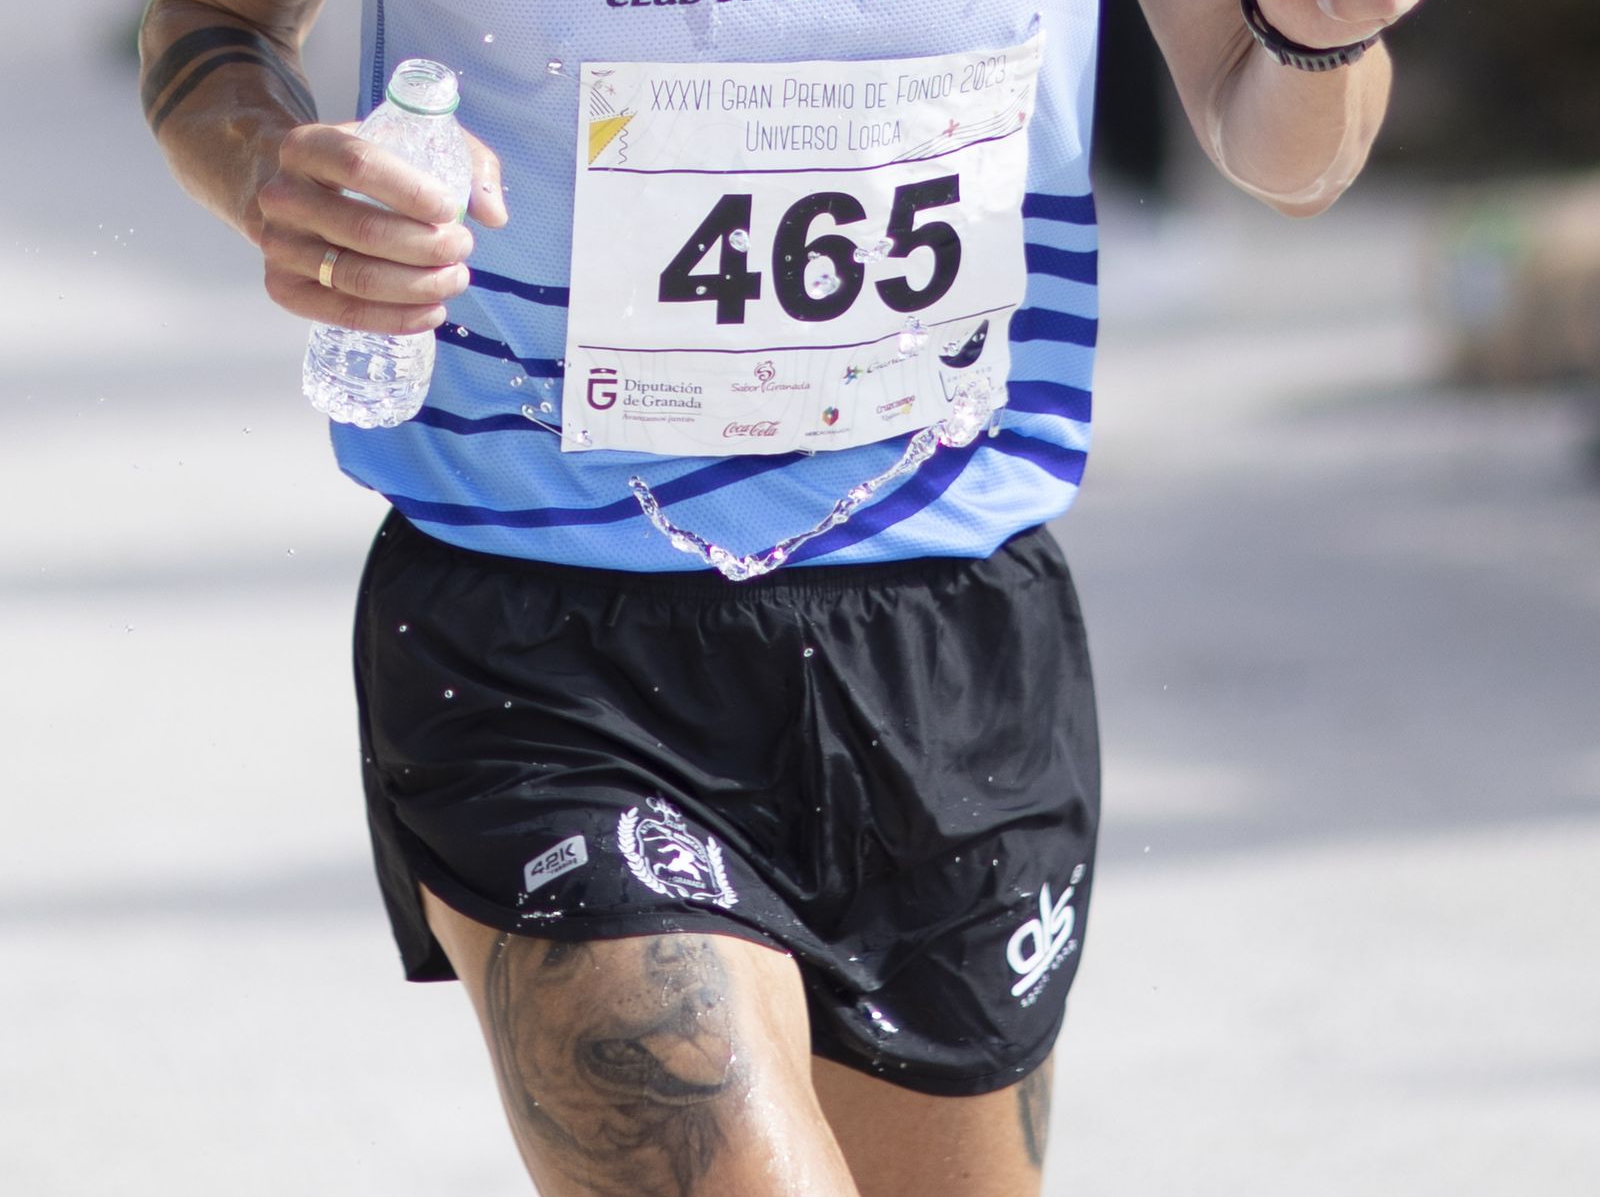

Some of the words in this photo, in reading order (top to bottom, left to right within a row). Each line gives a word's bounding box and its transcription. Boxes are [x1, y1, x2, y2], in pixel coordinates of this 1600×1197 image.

[650, 79, 712, 111] XXXVI
[721, 78, 773, 110] GRAN
[783, 78, 855, 109] PREMIO
[865, 82, 888, 109] DE
[960, 54, 1007, 94] 2023
[746, 120, 838, 152] UNIVERSO
[848, 119, 902, 151] LORCA
[658, 173, 962, 325] 465
[622, 396, 641, 408] de
[642, 397, 702, 410] Granada
[624, 379, 703, 395] Diputación
[731, 381, 760, 393] Sabor
[530, 842, 576, 877] 42K
